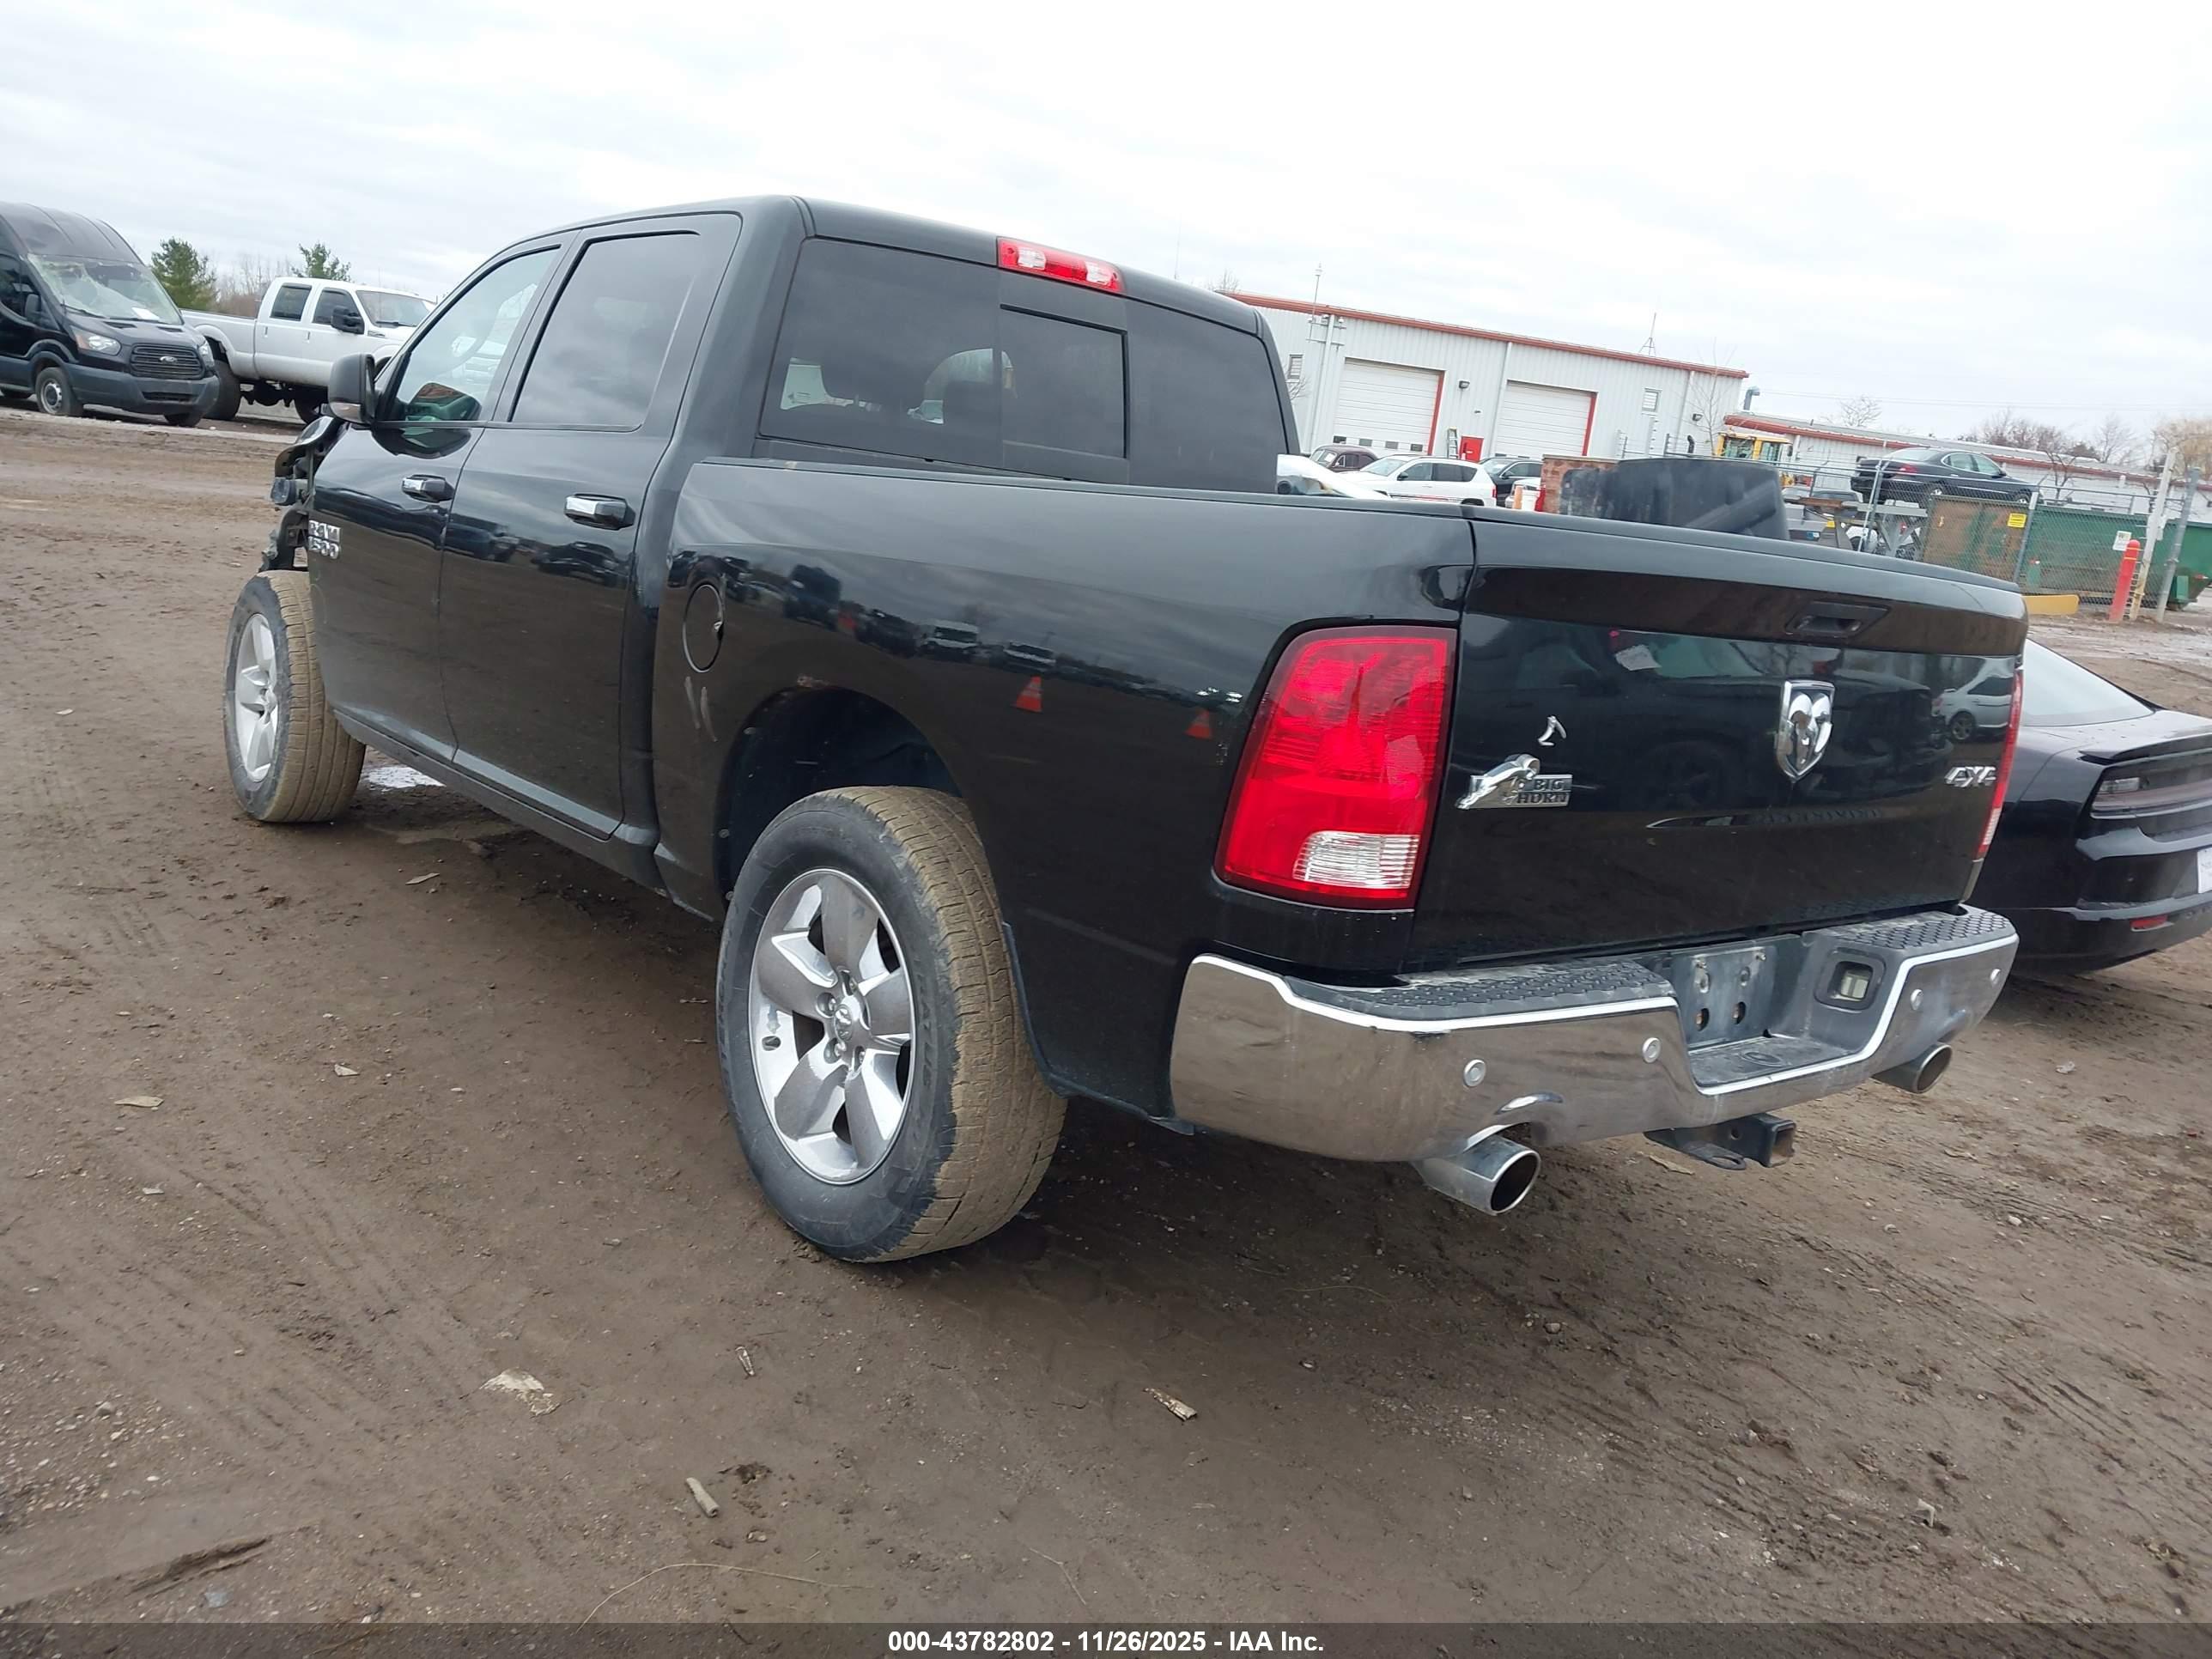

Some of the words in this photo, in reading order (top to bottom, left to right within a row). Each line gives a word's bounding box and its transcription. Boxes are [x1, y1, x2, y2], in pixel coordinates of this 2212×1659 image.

[309, 520, 341, 542] RAM
[308, 536, 339, 559] 1500
[1534, 778, 1565, 791] BIG
[1516, 792, 1569, 804] HORN
